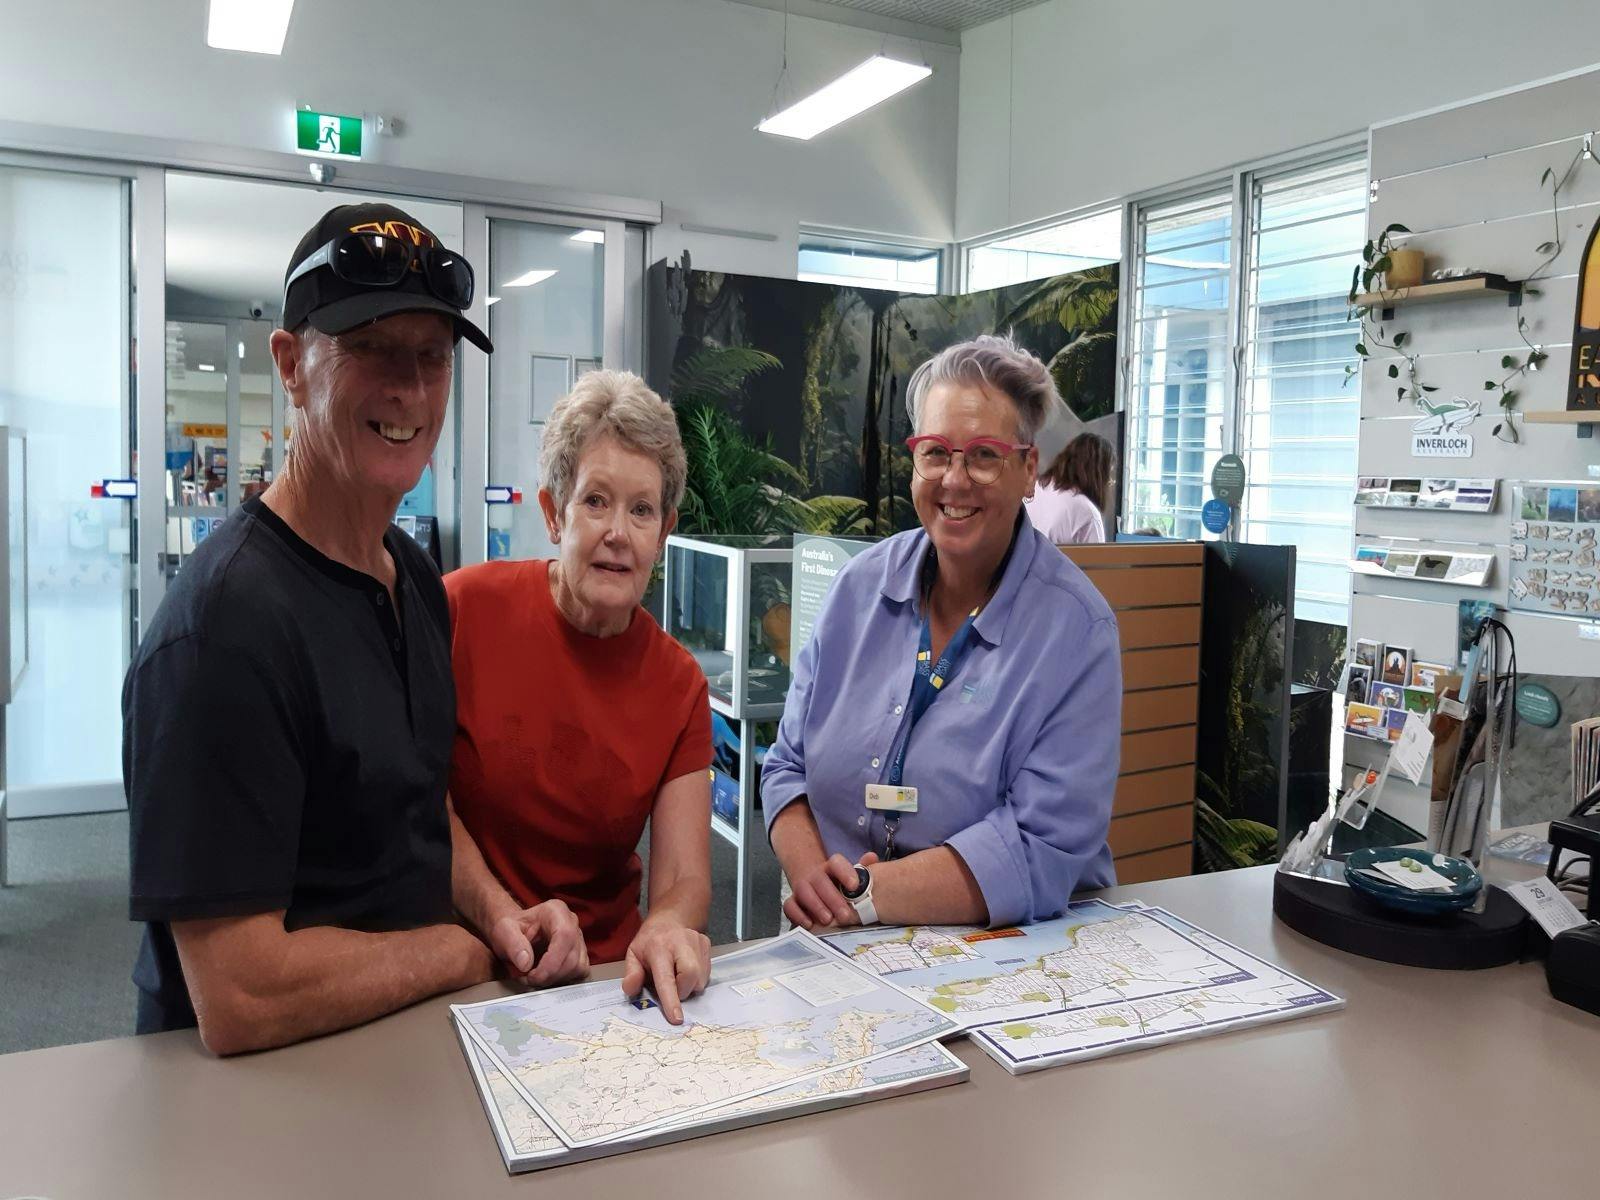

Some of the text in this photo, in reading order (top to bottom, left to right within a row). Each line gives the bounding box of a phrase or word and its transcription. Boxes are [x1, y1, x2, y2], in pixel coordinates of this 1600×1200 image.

[1416, 438, 1467, 449] INVERLOCH
[801, 547, 834, 562] Australia's
[801, 562, 816, 574] First
[1530, 887, 1546, 899] 29
